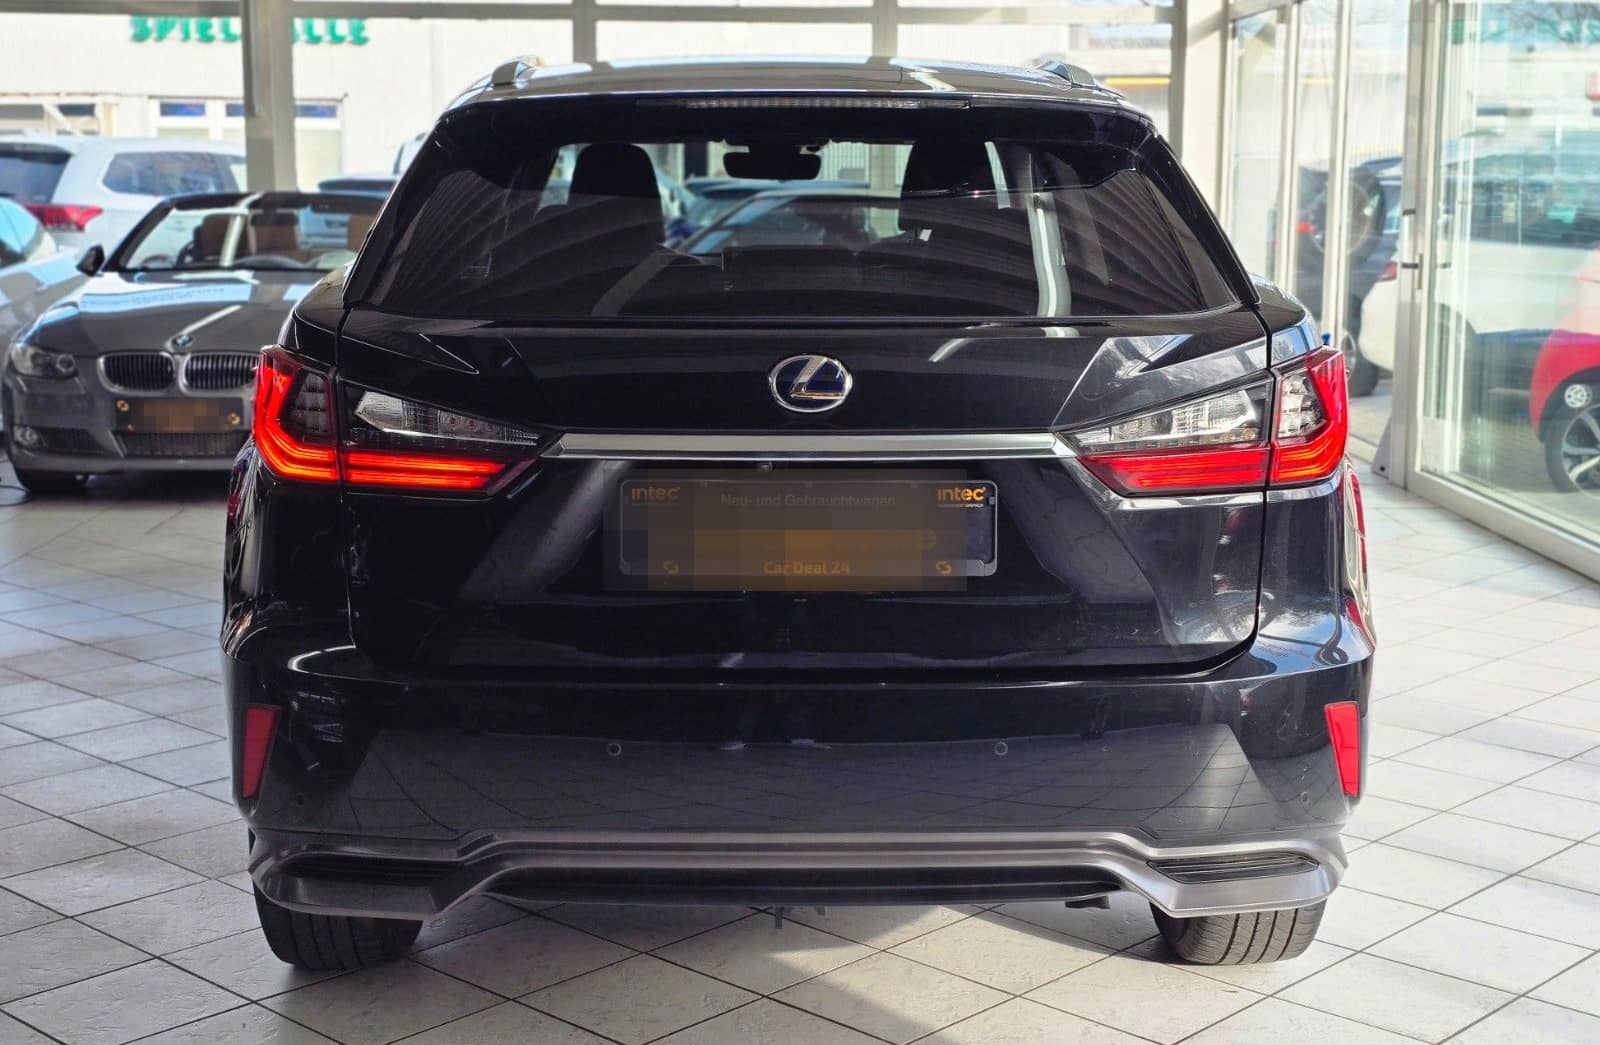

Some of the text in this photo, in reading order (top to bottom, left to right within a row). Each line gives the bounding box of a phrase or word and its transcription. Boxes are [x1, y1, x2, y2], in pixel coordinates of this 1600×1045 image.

[130, 15, 369, 45] SPIELLLE
[756, 493, 781, 506] und
[936, 486, 987, 501] intec
[763, 561, 851, 575] Car Deal 24
